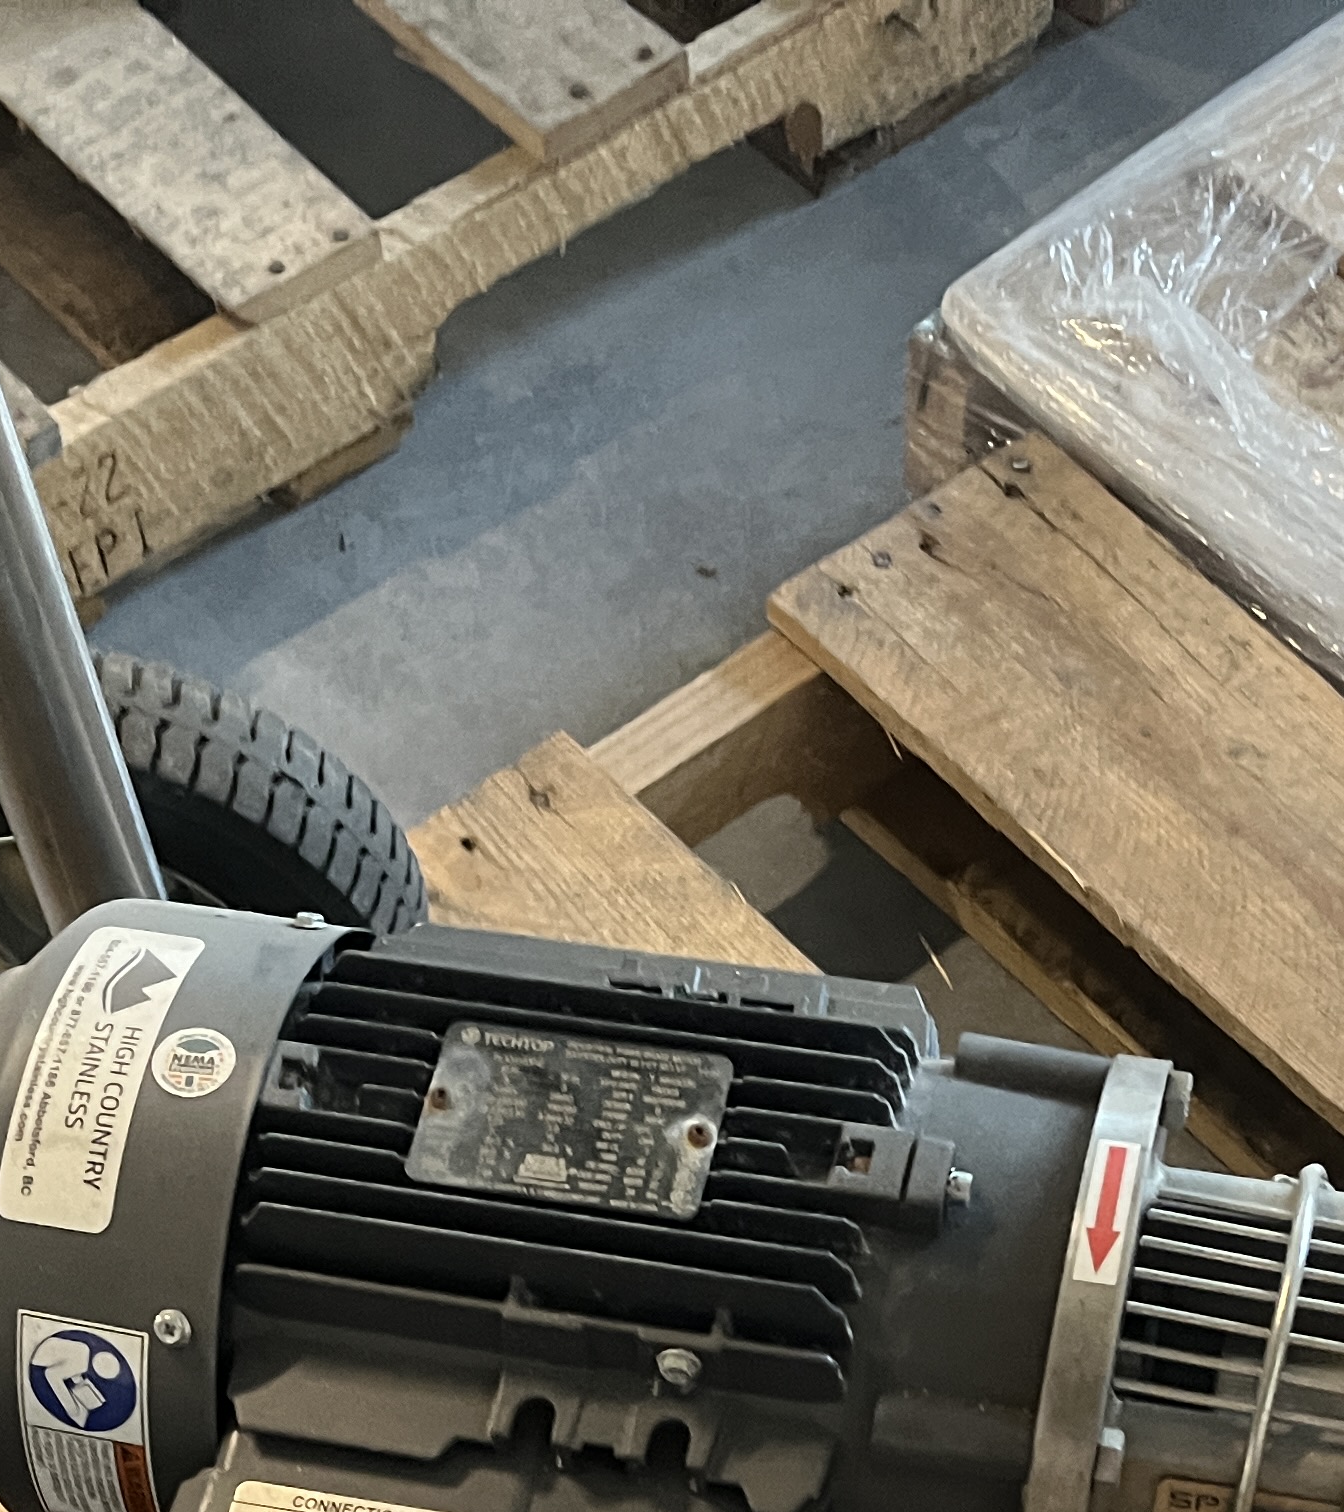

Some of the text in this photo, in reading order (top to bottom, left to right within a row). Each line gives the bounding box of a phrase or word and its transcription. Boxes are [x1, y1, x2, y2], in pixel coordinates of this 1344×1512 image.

[64, 1021, 114, 1129] STAINLESS
[171, 1053, 216, 1067] NEMA
[23, 1091, 52, 1170] Abbotsford,
[83, 1026, 143, 1191] HIGH COUNTRY
[21, 1175, 34, 1197] BC
